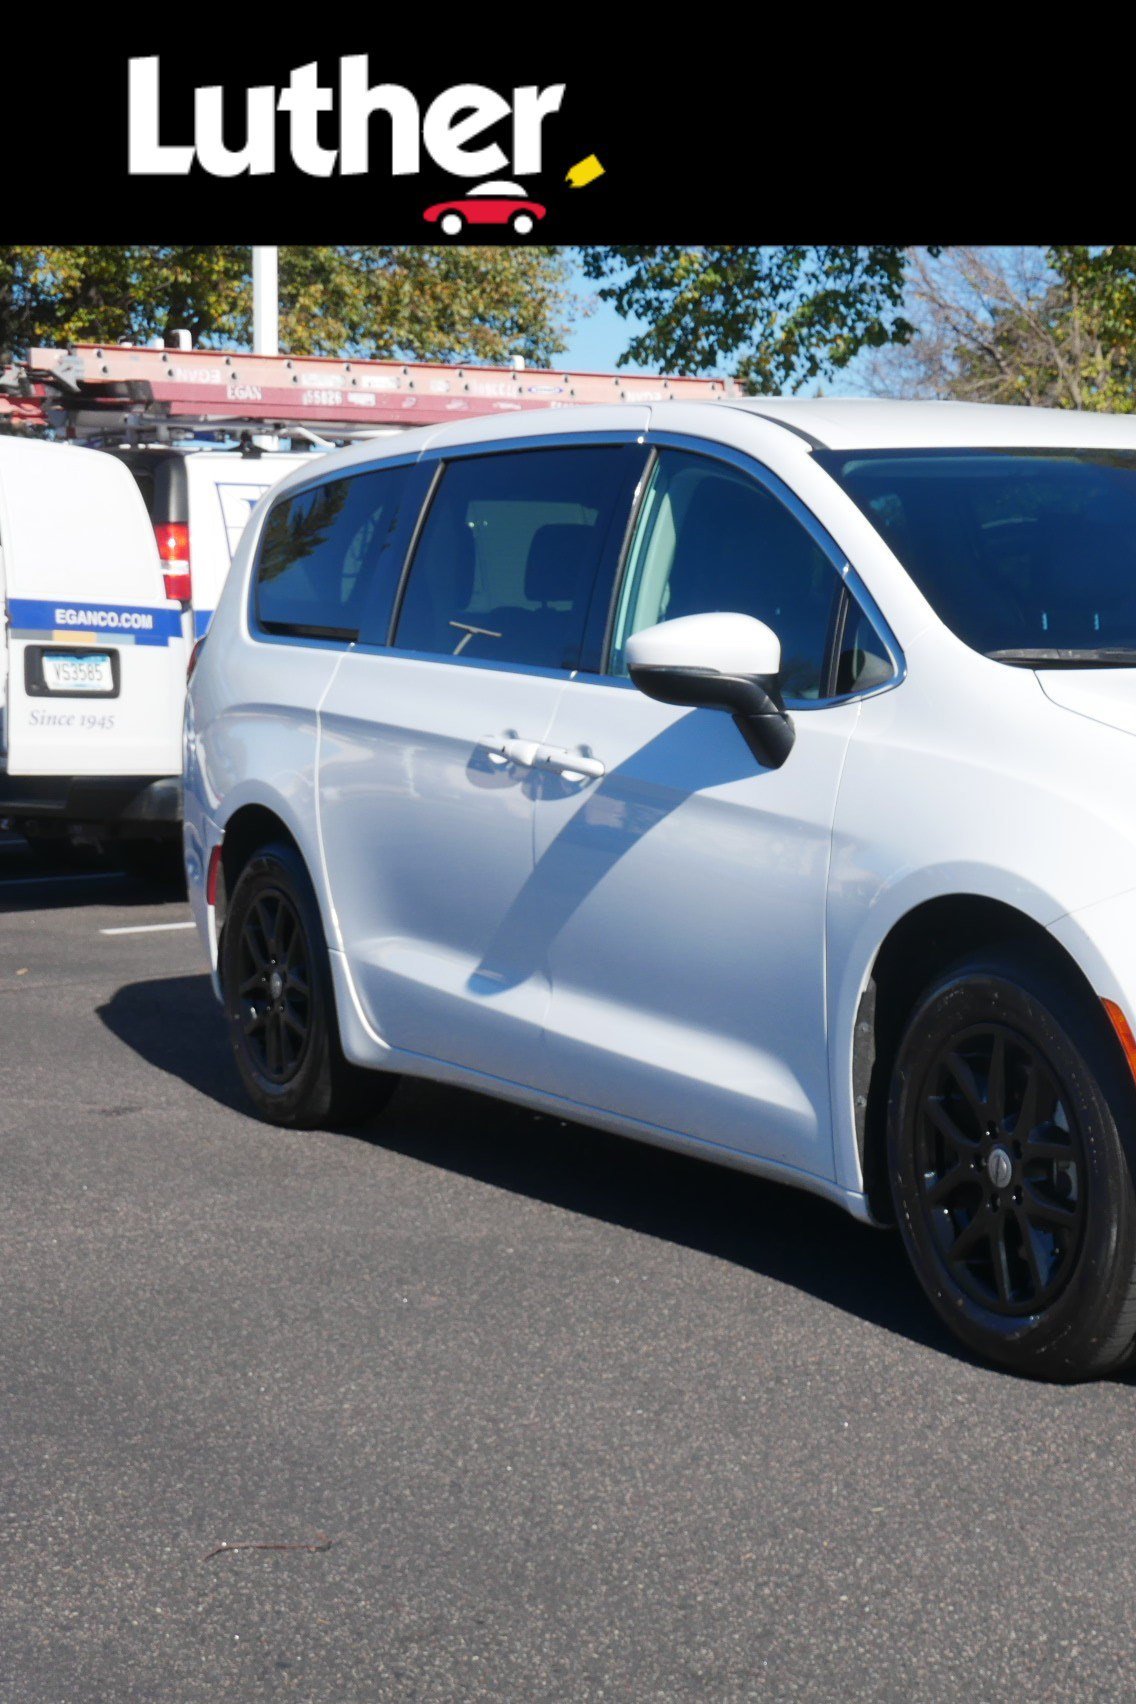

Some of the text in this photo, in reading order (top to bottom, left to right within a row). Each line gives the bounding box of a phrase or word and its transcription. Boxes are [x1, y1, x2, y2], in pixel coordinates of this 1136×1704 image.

[227, 383, 262, 400] EGAN
[55, 608, 153, 630] EGANCO.COM
[28, 708, 115, 730] Since 1945
